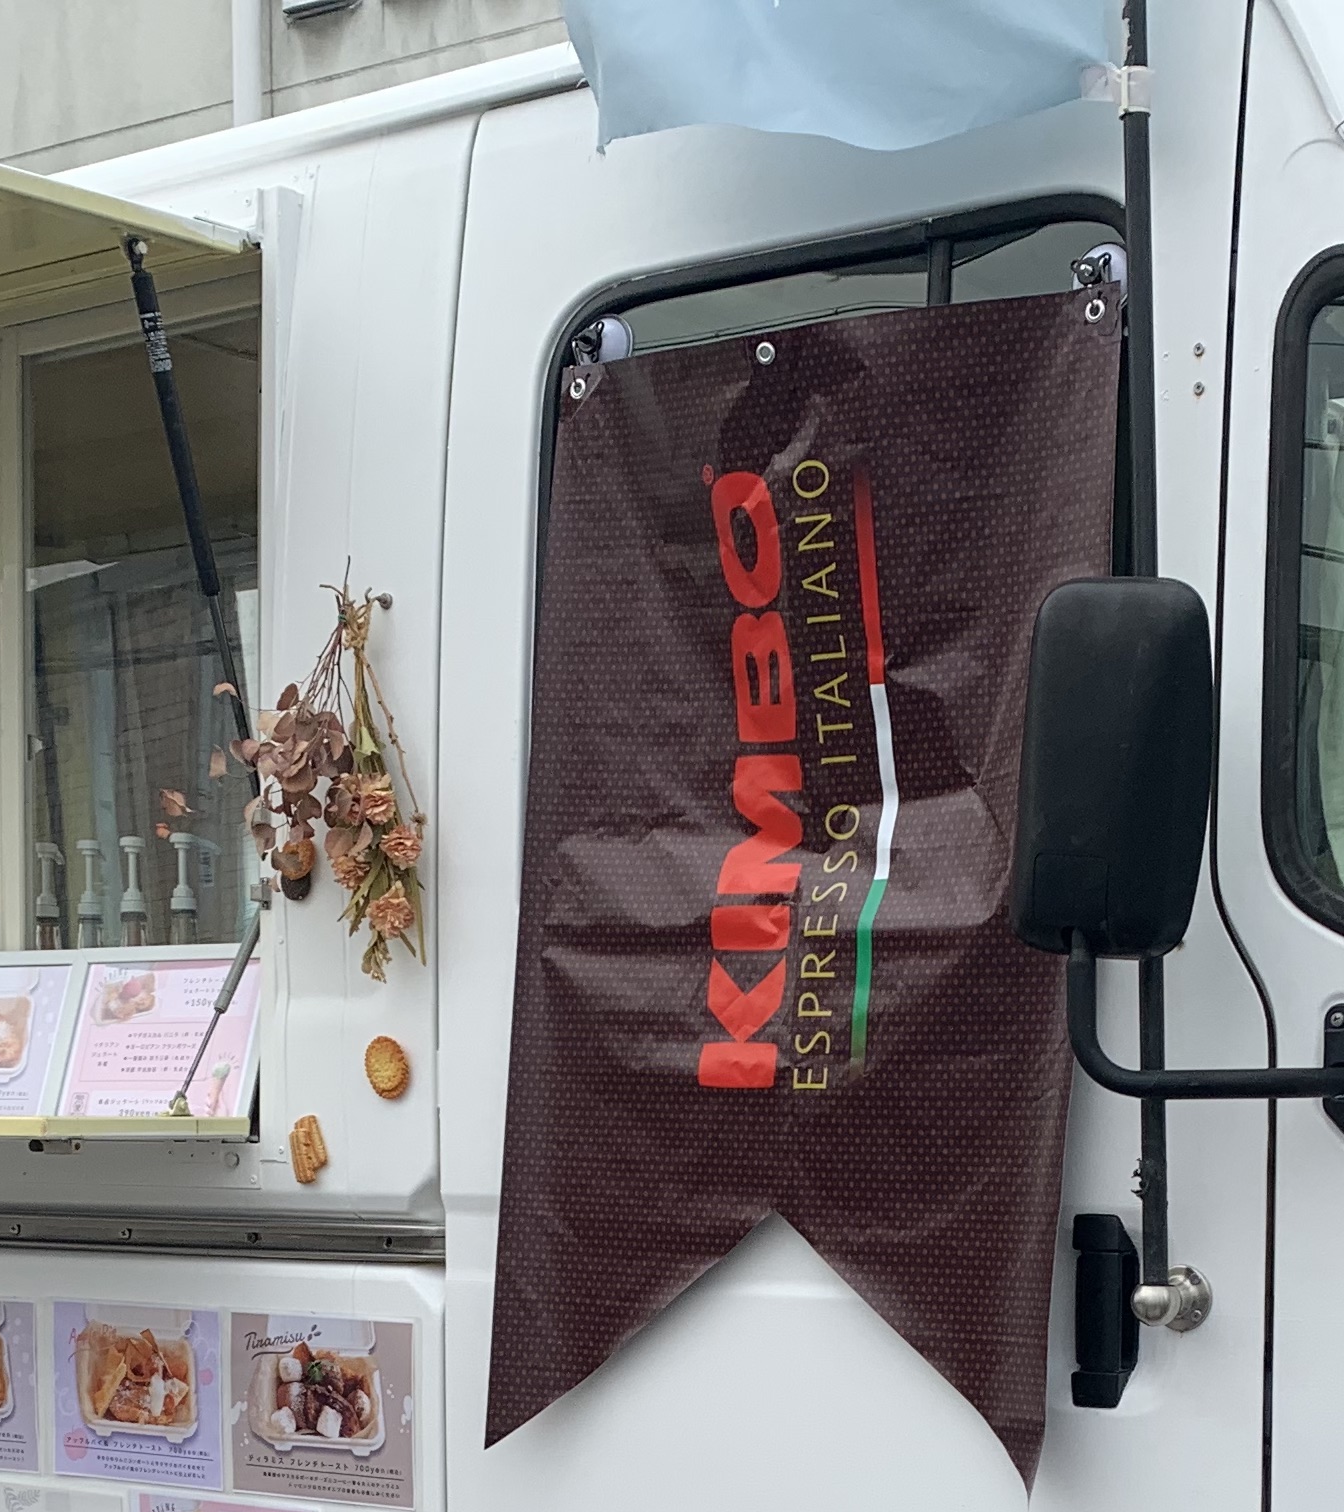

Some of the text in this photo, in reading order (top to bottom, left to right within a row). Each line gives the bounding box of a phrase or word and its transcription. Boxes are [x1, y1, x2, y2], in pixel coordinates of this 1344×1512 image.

[697, 470, 803, 1089] KIMBO
[792, 458, 860, 1092] ESPRESSO ITALIANO
